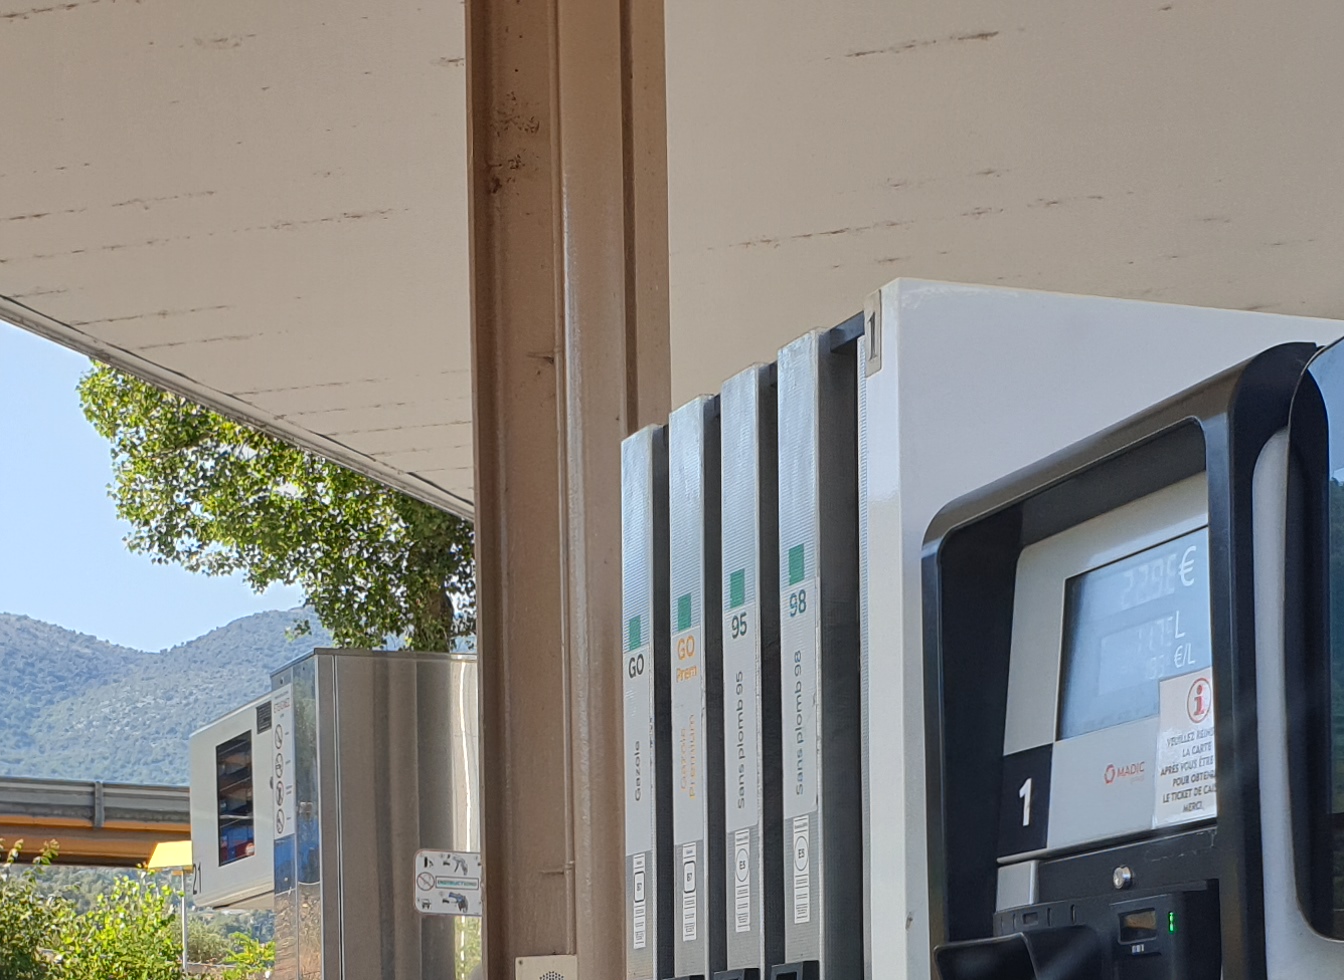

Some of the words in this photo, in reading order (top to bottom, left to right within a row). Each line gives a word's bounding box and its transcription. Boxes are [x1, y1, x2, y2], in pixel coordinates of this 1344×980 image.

[1178, 545, 1197, 588] €
[788, 588, 808, 618] 98
[731, 611, 748, 640] 95
[1174, 609, 1186, 639] L
[677, 634, 696, 661] GO
[628, 652, 646, 679] GO
[793, 649, 803, 678] 98
[794, 680, 805, 745] plomb
[736, 698, 746, 760] plomb
[1191, 741, 1213, 755] CARTE
[634, 740, 642, 802] Gazole
[795, 747, 804, 796] Sans
[1116, 761, 1145, 778] MADIC
[737, 763, 745, 809] Sans
[1170, 788, 1193, 802] TICKET
[1018, 777, 1032, 827] 1
[192, 861, 202, 896] 21
